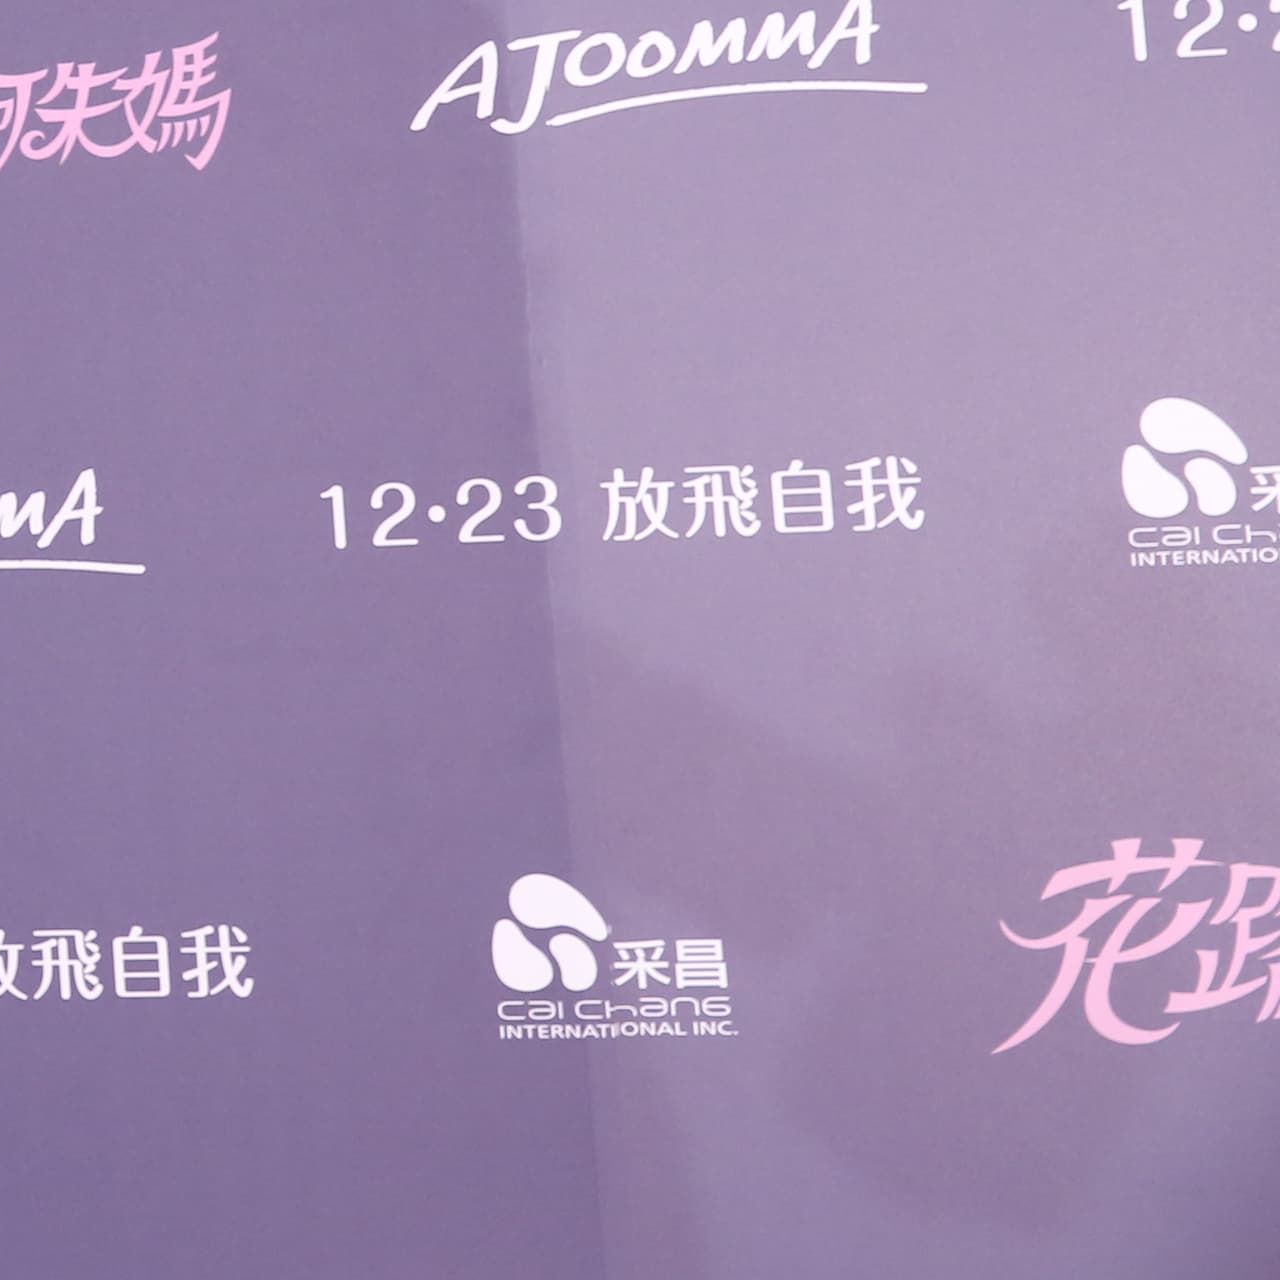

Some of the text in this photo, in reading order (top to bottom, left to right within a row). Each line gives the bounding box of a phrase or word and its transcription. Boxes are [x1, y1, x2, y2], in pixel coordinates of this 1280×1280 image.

[601, 455, 926, 542] 放飛自我
[612, 938, 729, 990] 采昌
[498, 1017, 741, 1040] INTERNATIONAL INC.
